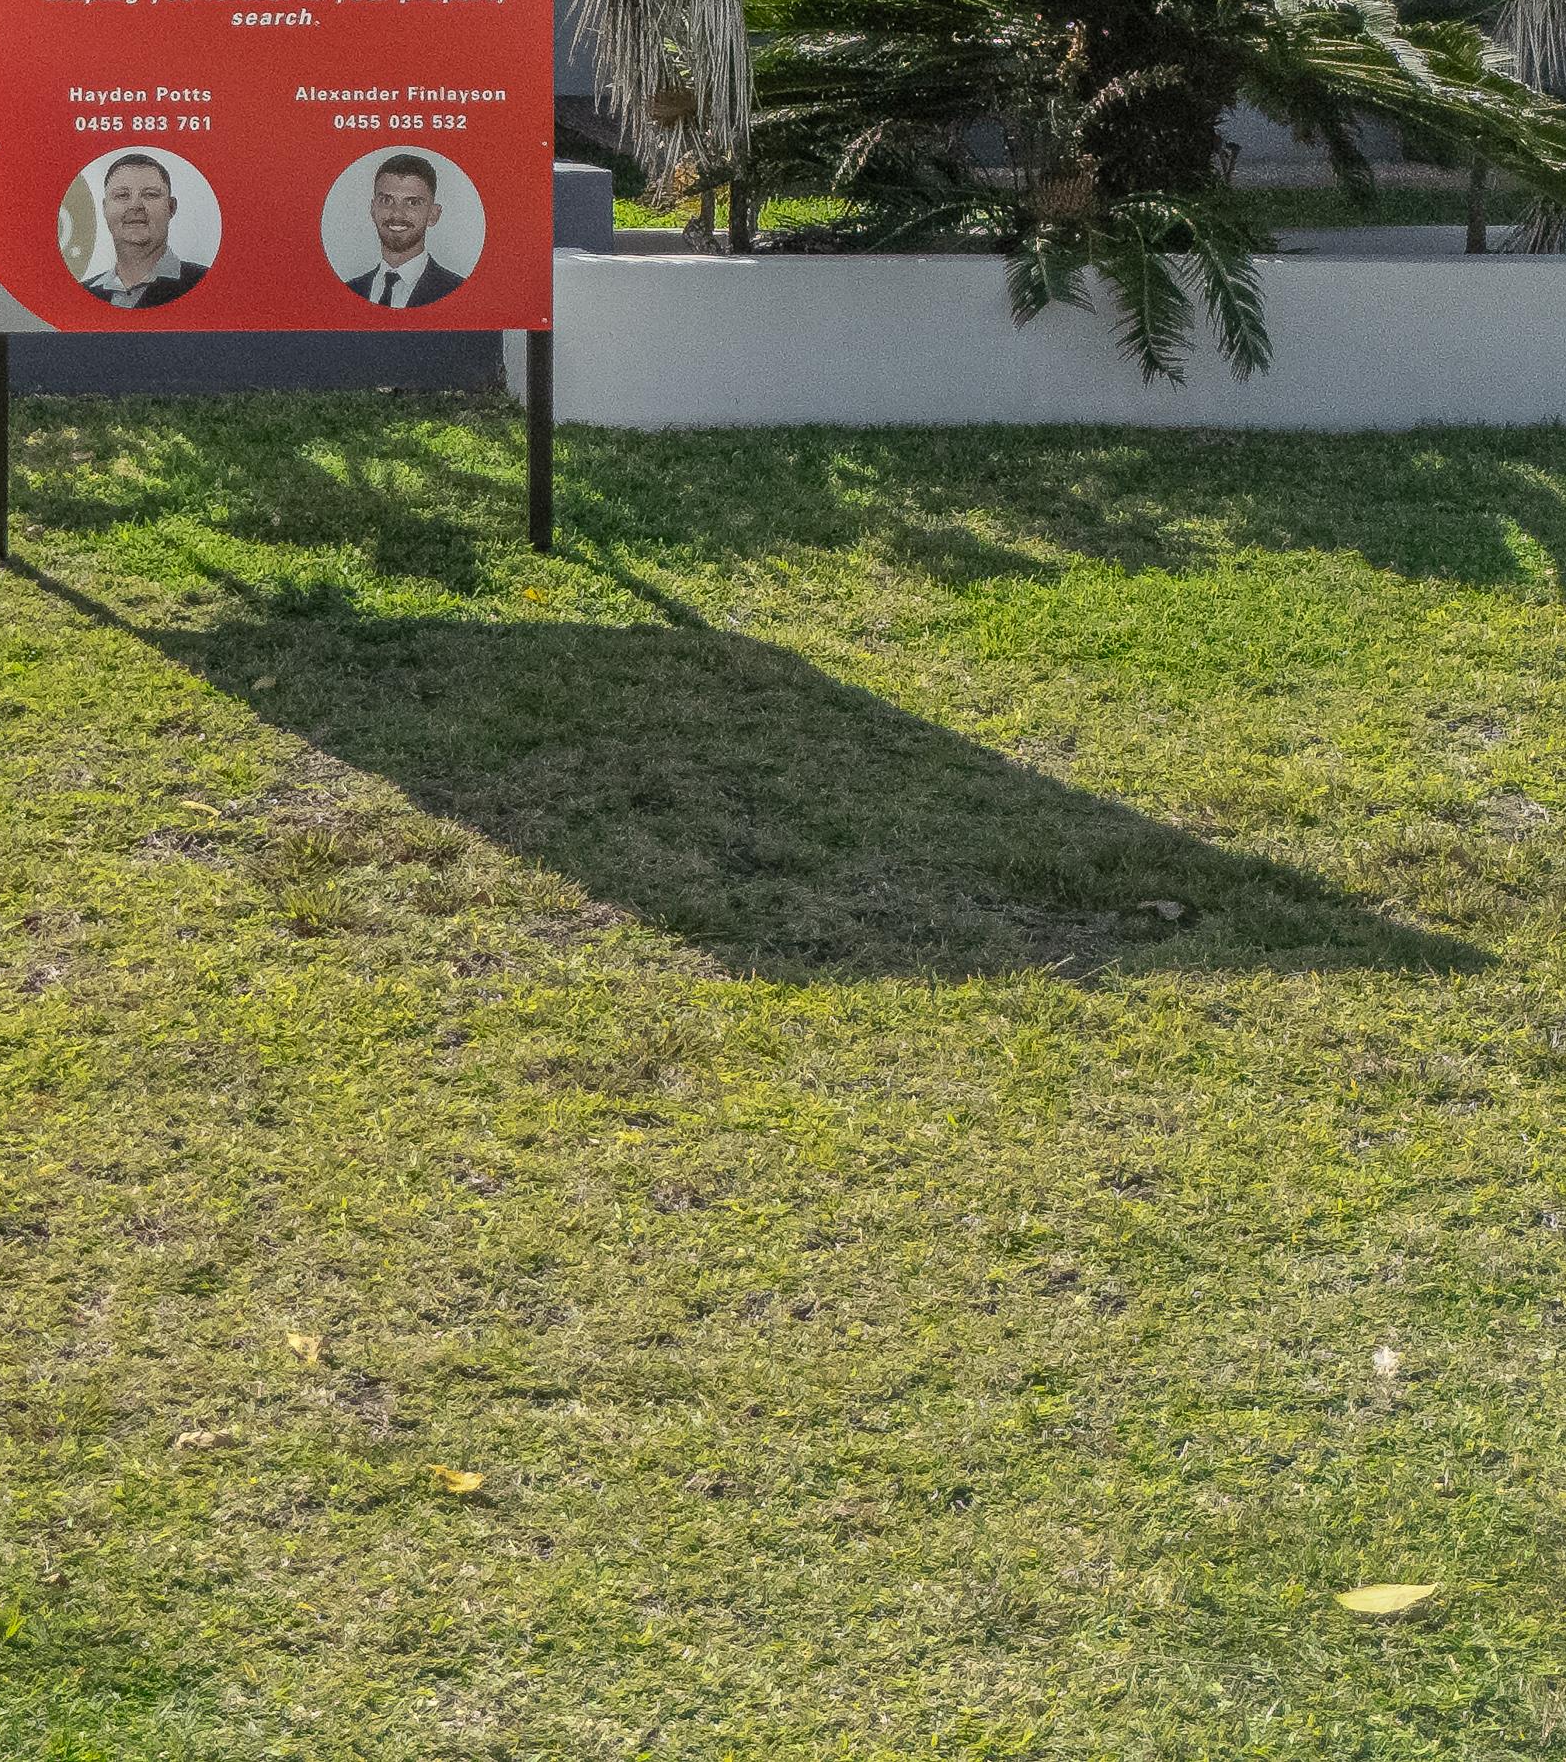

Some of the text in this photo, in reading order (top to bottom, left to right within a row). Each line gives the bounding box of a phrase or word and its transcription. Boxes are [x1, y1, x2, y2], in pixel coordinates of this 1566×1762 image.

[231, 8, 321, 26] search.
[69, 87, 212, 106] Hayden Potts
[295, 86, 507, 104] Alexander Finlayson
[75, 116, 212, 131] 0455 883 761
[334, 114, 468, 130] 0455 035 532
